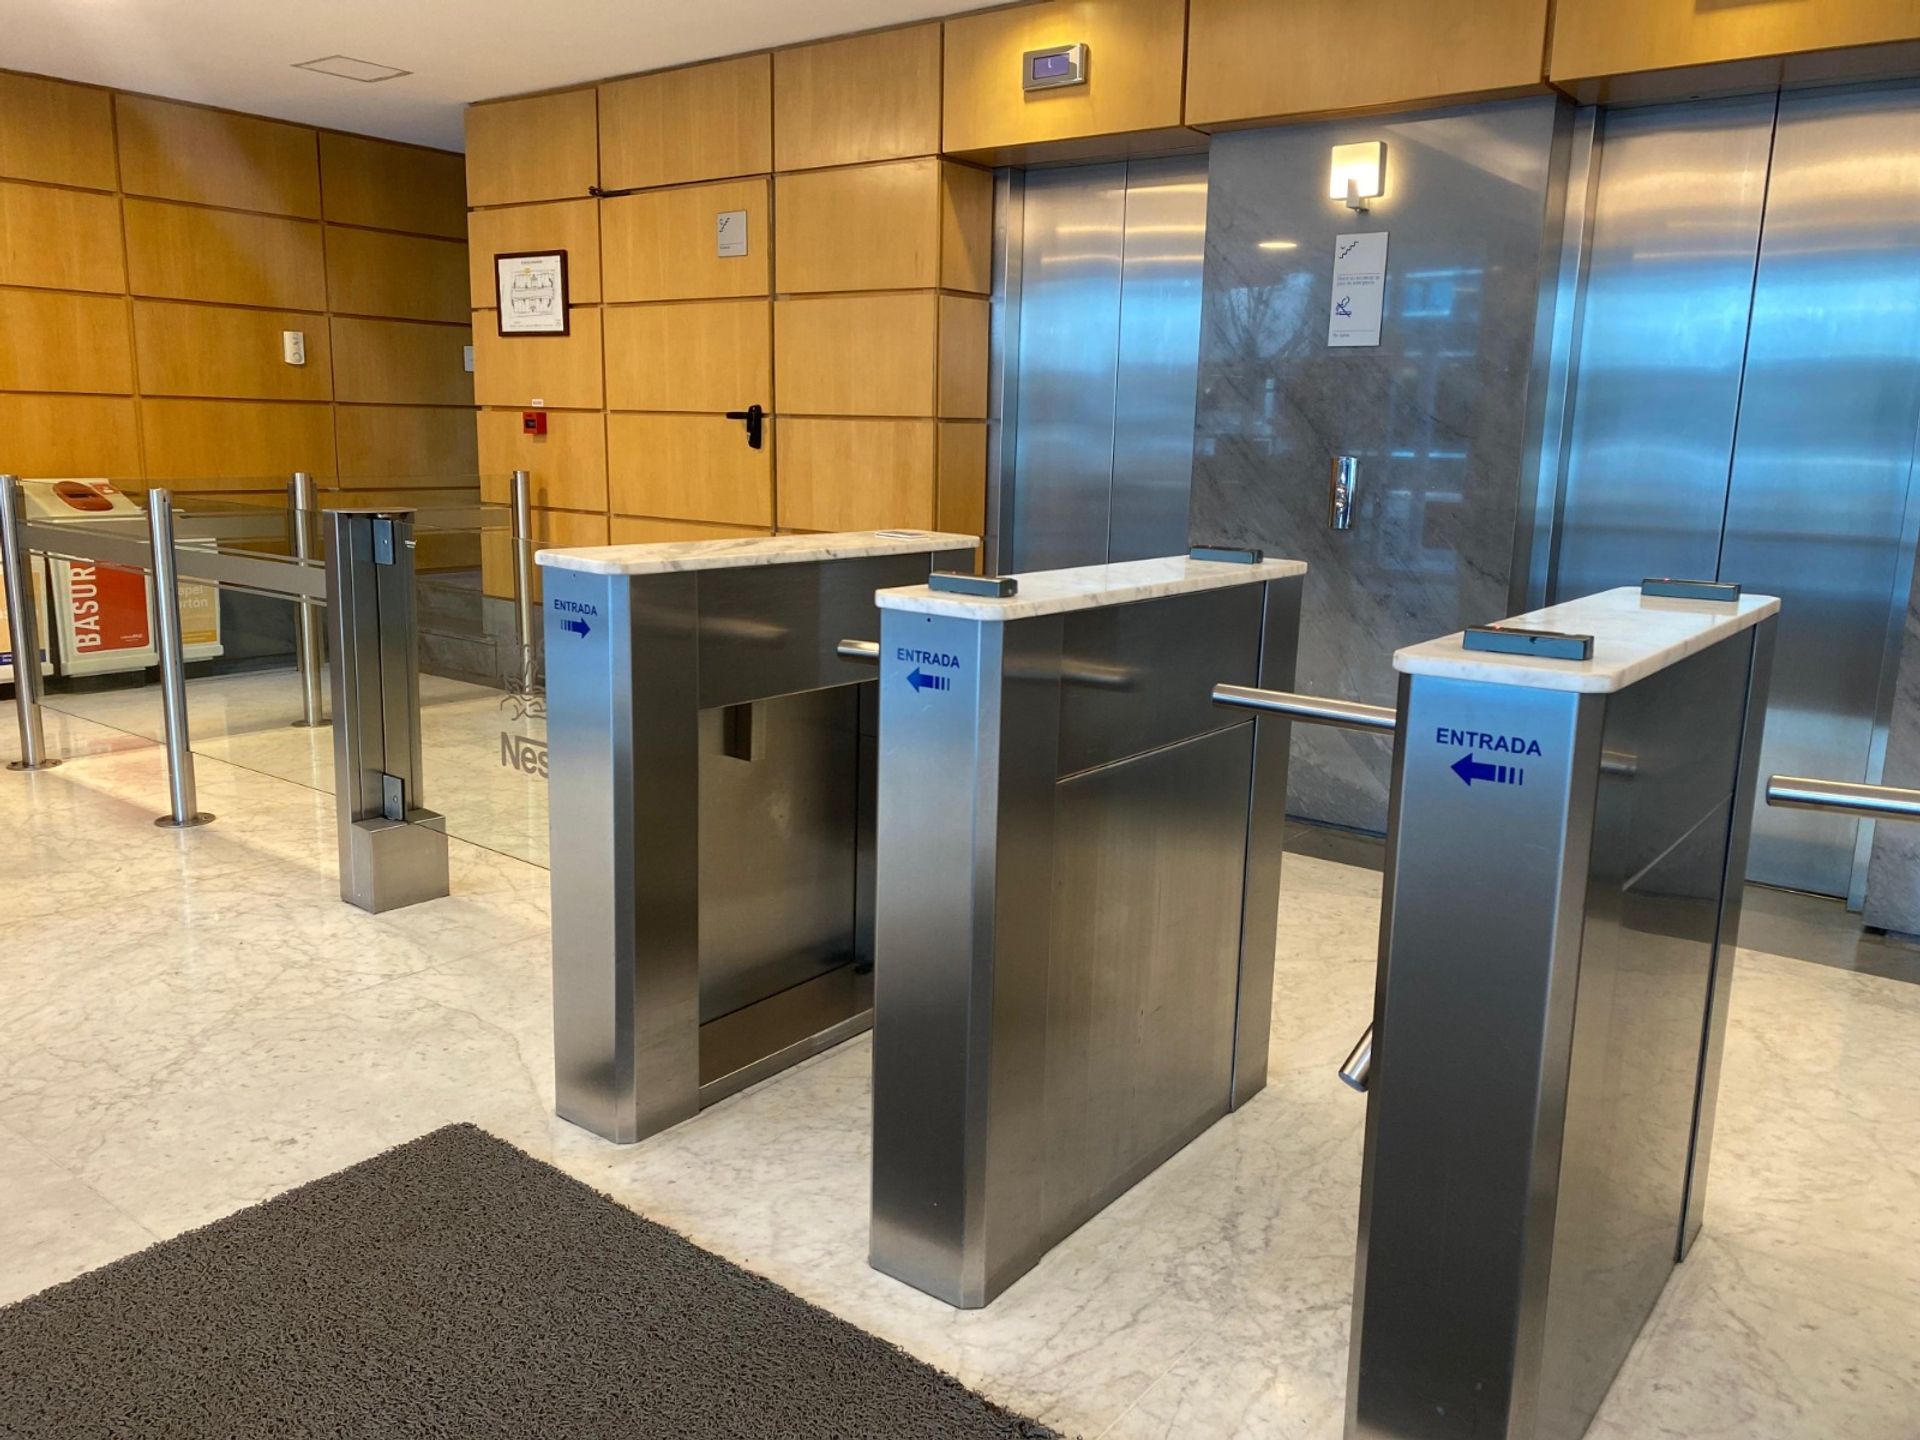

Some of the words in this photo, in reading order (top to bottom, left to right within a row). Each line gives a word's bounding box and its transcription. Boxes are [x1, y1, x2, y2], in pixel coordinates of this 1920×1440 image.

[178, 584, 204, 598] apel
[70, 566, 101, 646] BASUR
[554, 599, 598, 616] ENTRADA
[897, 648, 960, 669] ENTRADA
[1436, 727, 1542, 757] ENTRADA
[501, 731, 549, 779] Nes
